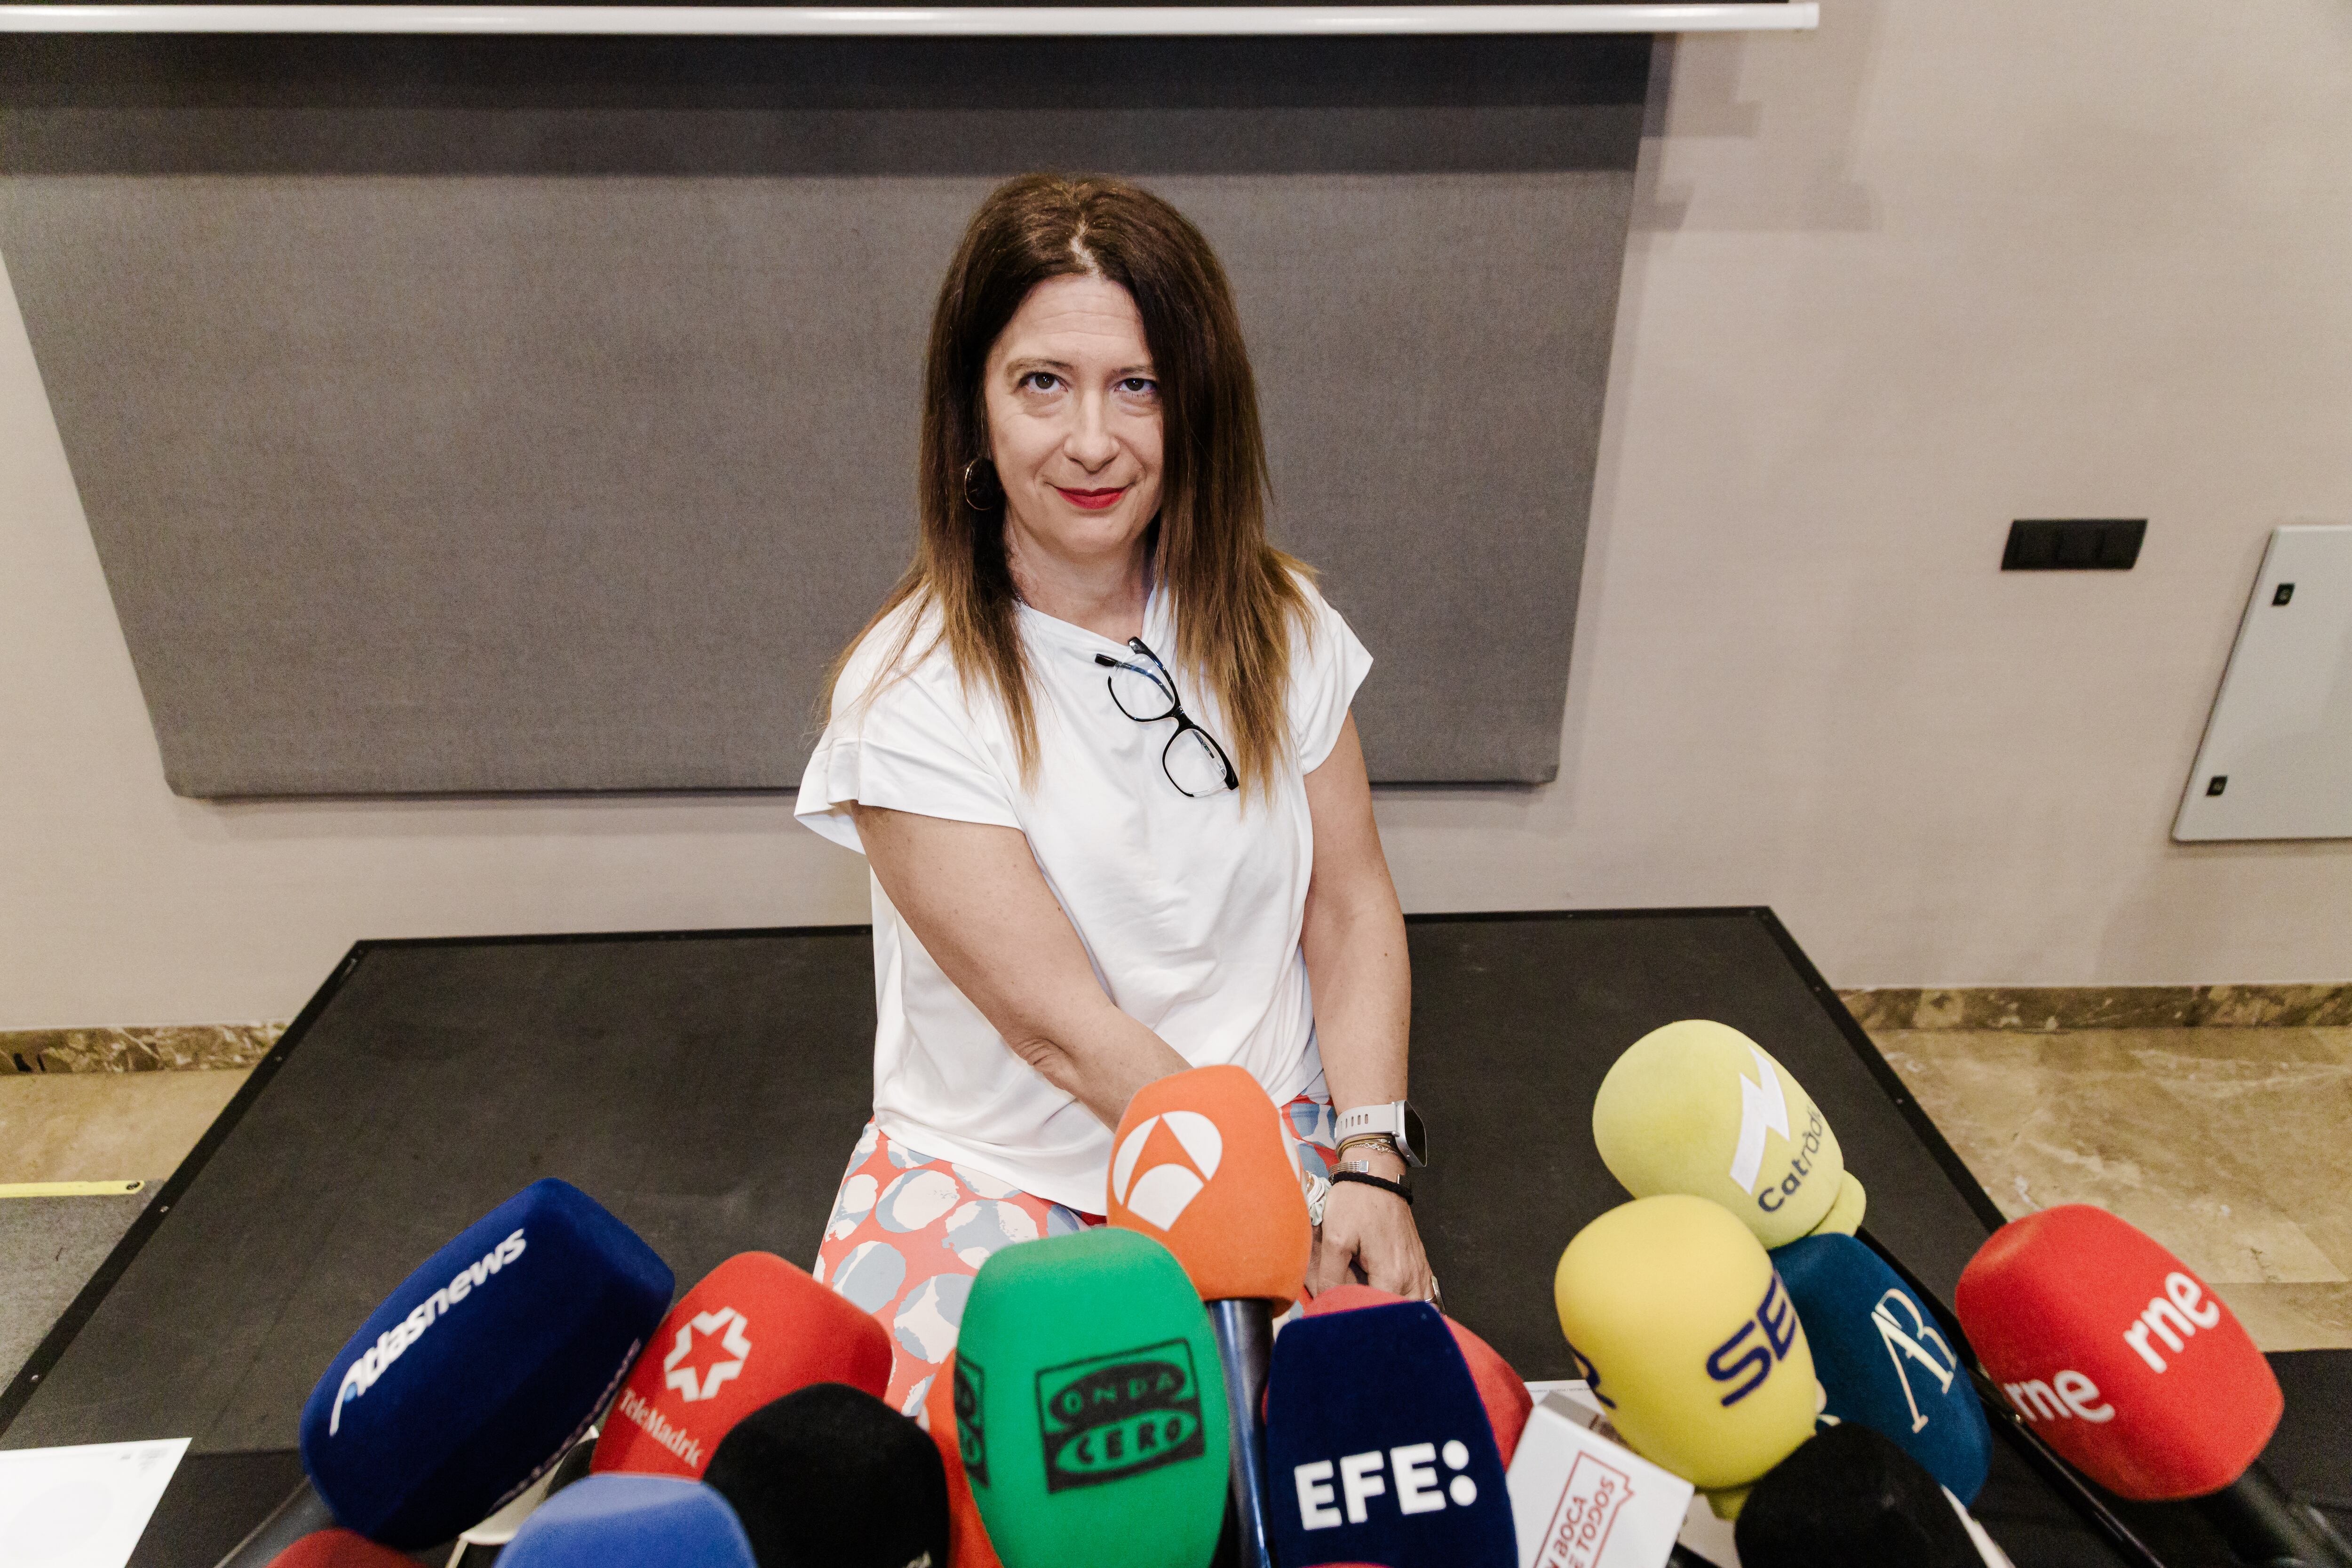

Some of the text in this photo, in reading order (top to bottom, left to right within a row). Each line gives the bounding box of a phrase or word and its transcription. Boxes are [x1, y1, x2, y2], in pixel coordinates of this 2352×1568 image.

[1757, 1102, 1824, 1213] Catràdi
[329, 1228, 527, 1437] Atlasnews
[1706, 1269, 1797, 1407] SE
[1871, 1288, 1957, 1433] AB
[2123, 1272, 2221, 1374] rne
[1062, 1371, 1175, 1416] ONDA
[1075, 1417, 1183, 1465] CERO
[2003, 1370, 2116, 1423] rne
[1576, 1475, 1614, 1552] TODOS
